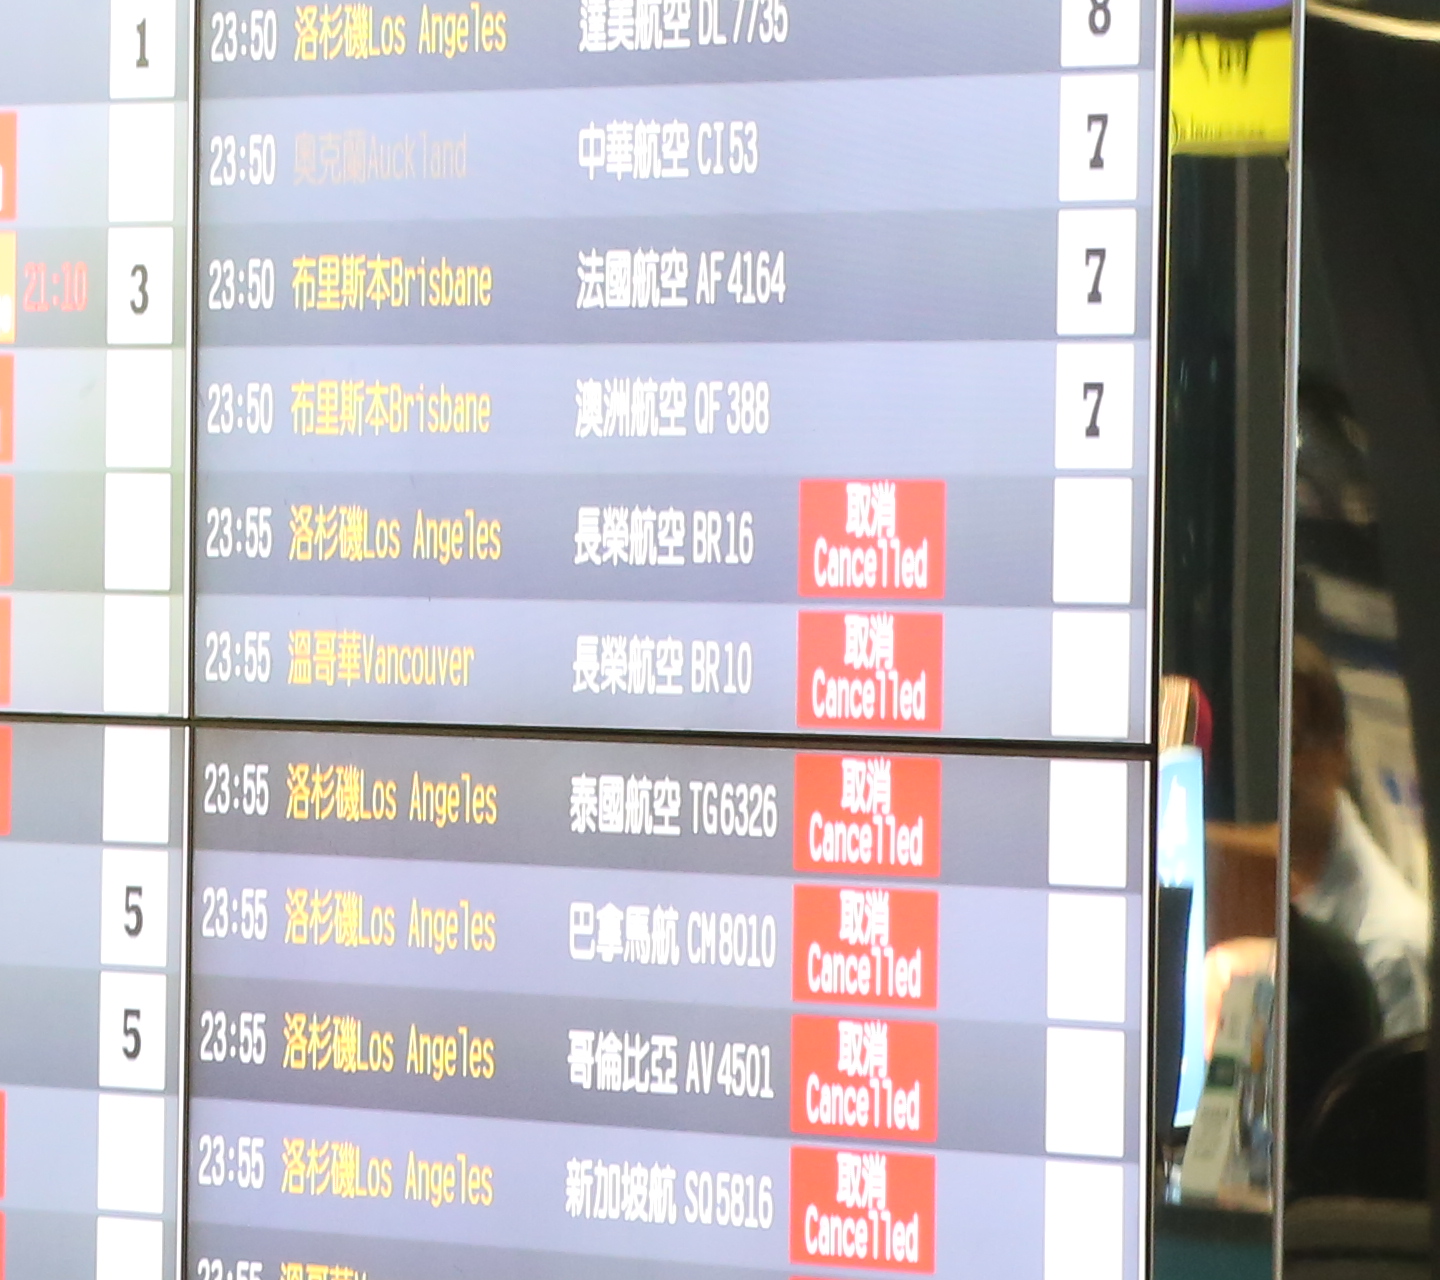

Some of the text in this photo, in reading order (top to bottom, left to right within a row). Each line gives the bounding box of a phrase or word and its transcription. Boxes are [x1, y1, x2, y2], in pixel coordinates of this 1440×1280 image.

[135, 19, 149, 68] 1
[22, 261, 88, 313] 21:10
[130, 264, 149, 314] 3
[209, 258, 275, 310] 23:50
[577, 247, 688, 309] 法國航空
[1086, 248, 1106, 303] 7
[206, 506, 272, 558] 23:55
[413, 508, 501, 565] Angeles
[574, 505, 686, 566] 長榮航空
[846, 483, 896, 538] 取消
[816, 536, 928, 588] Cancelled
[122, 1008, 141, 1059] 5
[200, 1010, 266, 1064] 23:55
[406, 1023, 494, 1081] Angeles
[567, 1029, 678, 1094] 哥倫比亞
[838, 1021, 888, 1078] 取消
[807, 1073, 920, 1130] Cancelled
